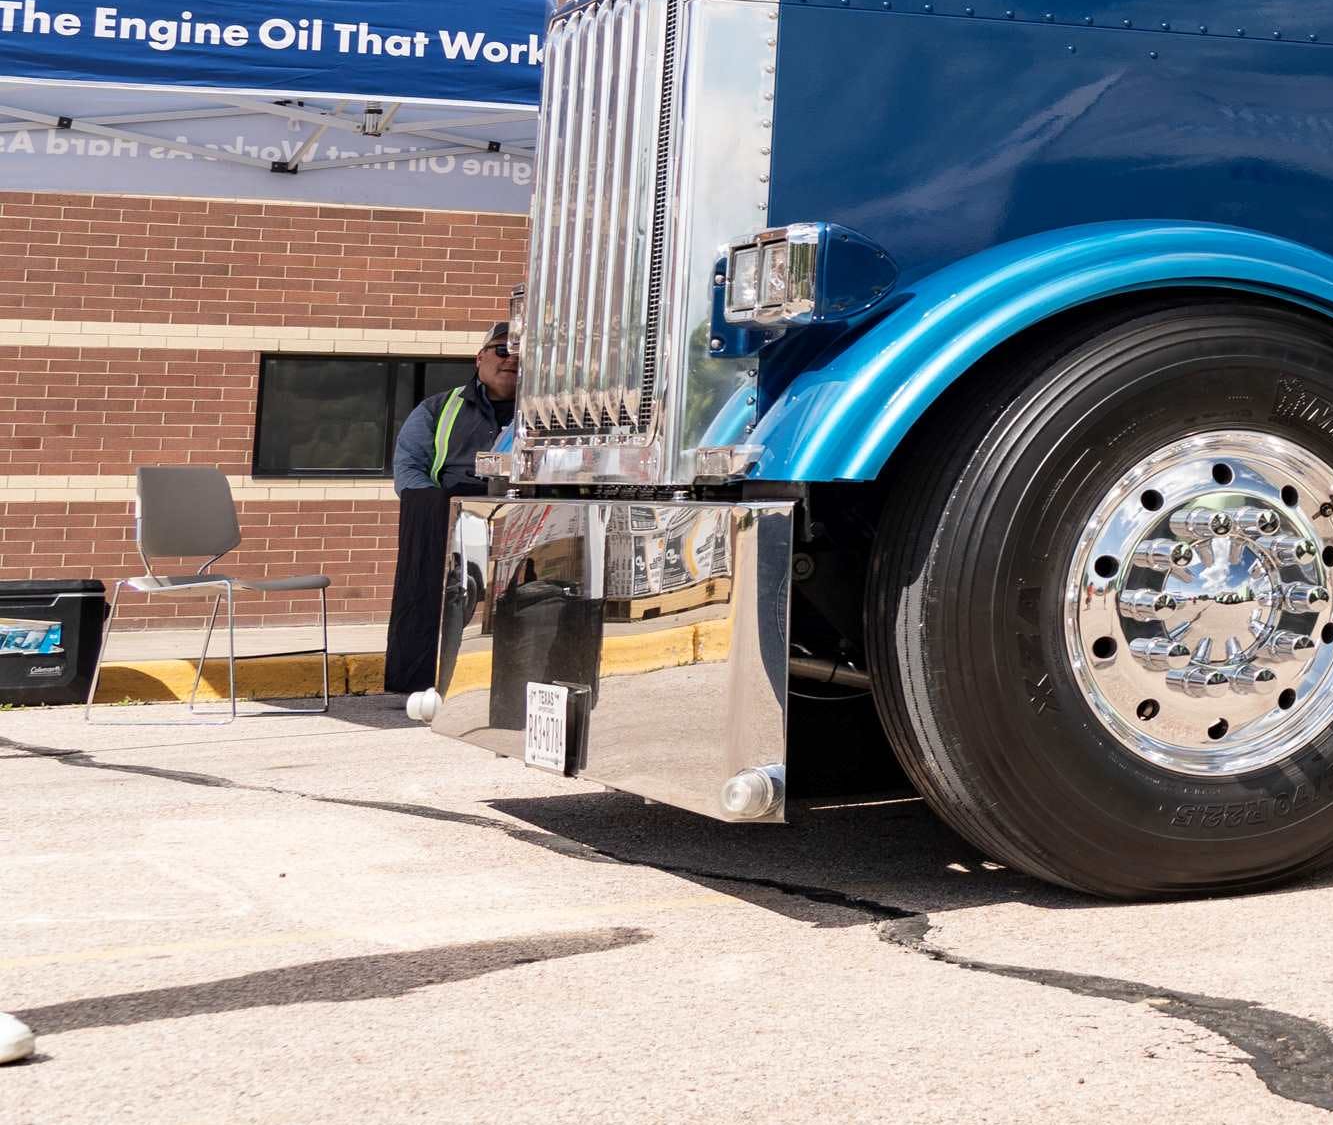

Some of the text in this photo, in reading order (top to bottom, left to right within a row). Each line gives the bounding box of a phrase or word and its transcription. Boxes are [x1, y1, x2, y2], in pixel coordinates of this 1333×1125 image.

[0, 0, 545, 66] The Engine Oil That Work
